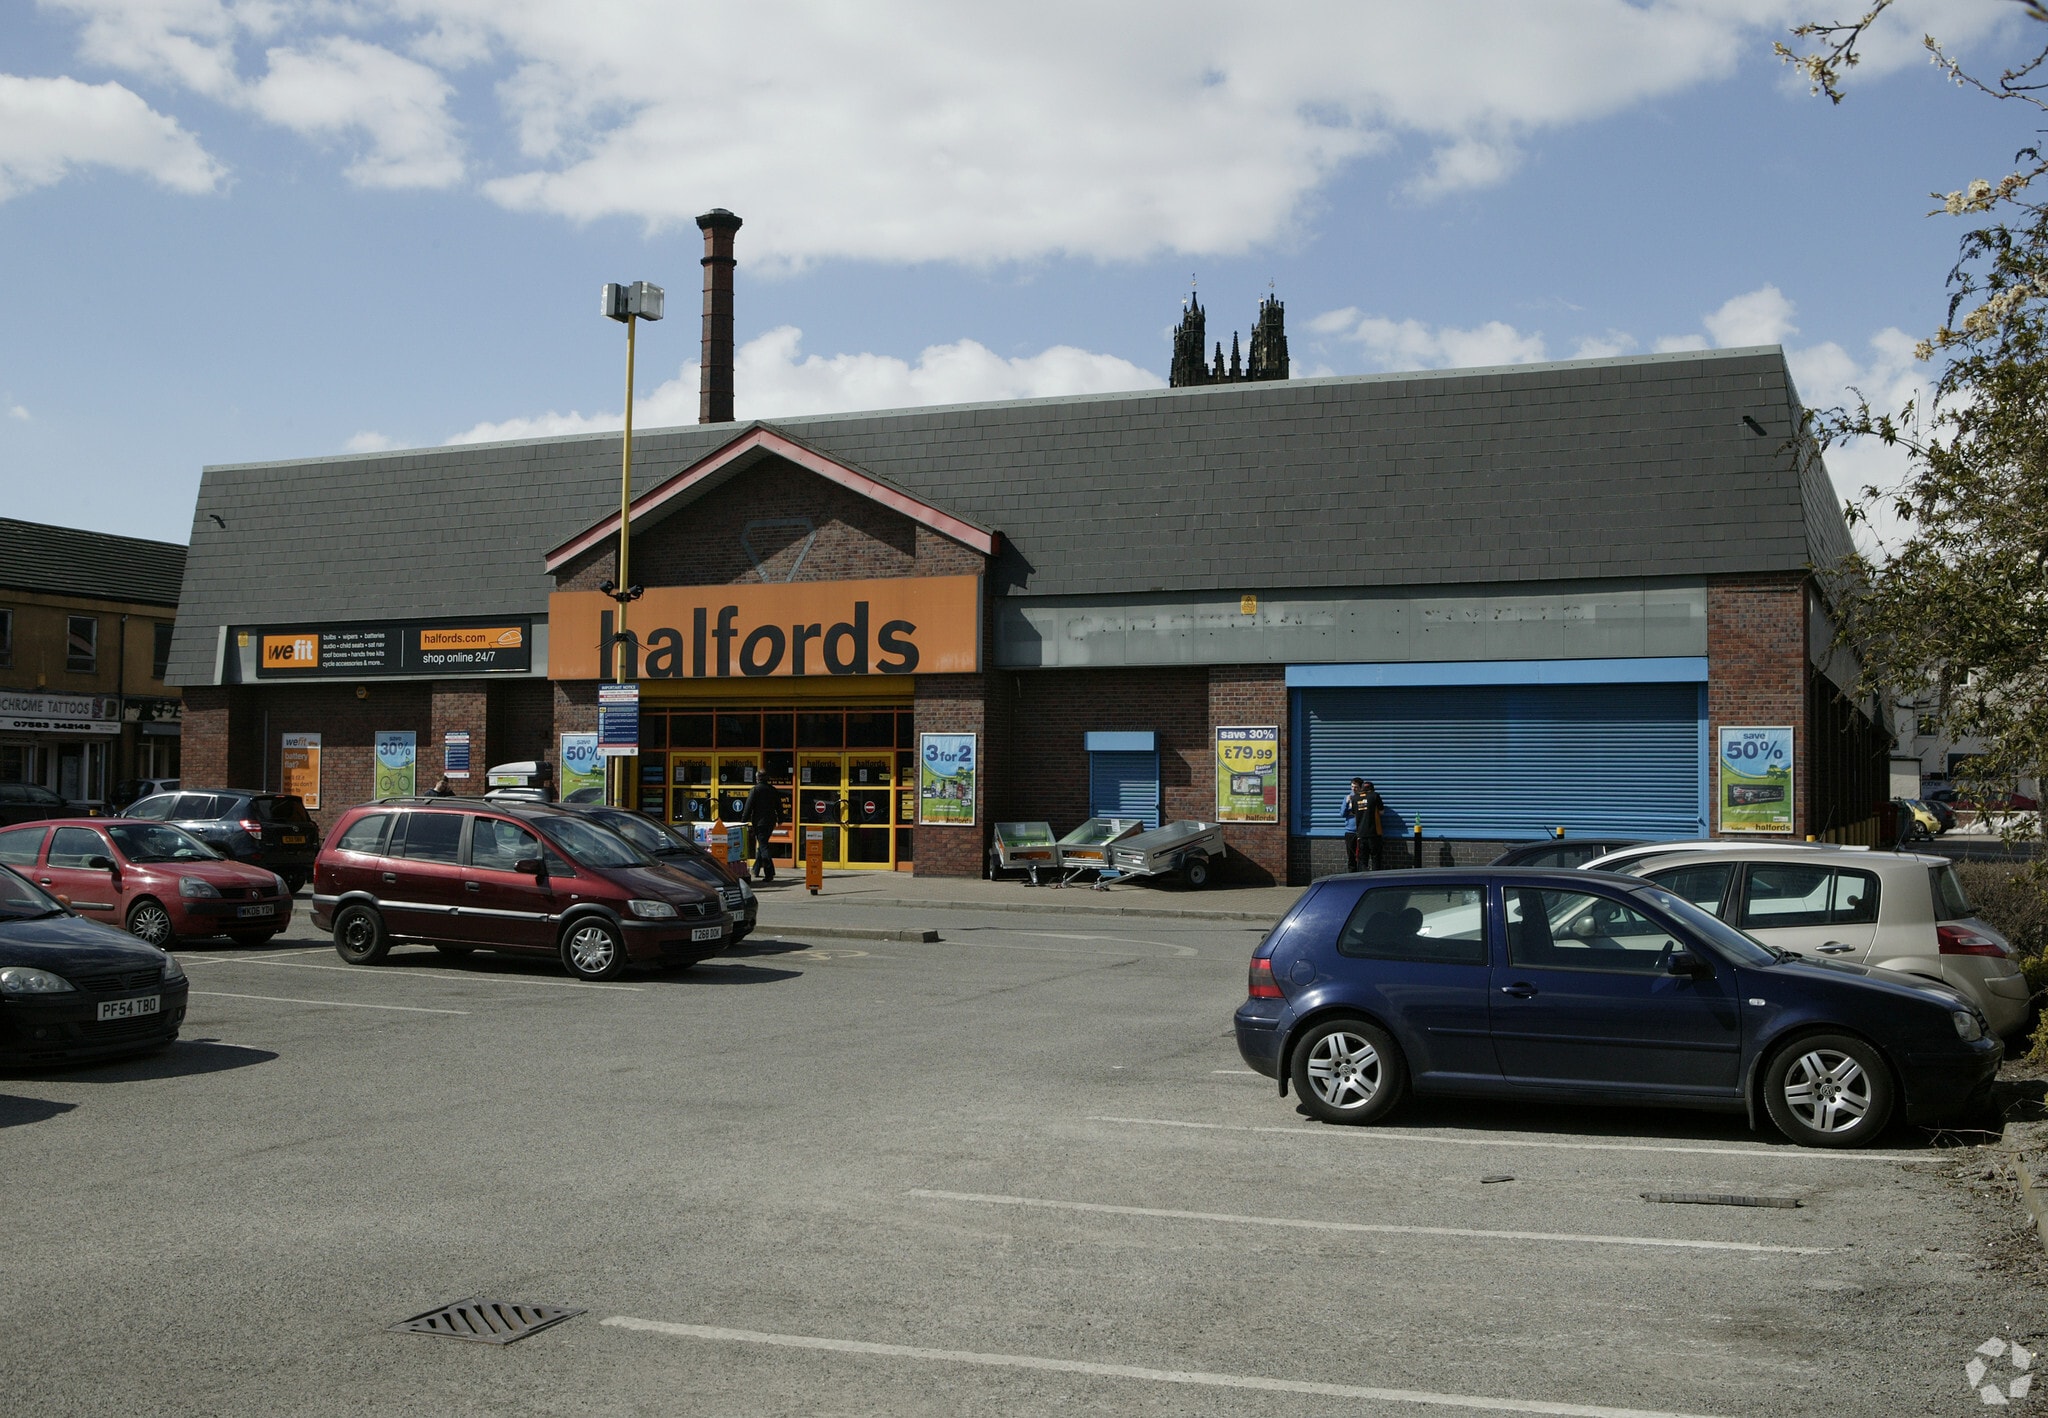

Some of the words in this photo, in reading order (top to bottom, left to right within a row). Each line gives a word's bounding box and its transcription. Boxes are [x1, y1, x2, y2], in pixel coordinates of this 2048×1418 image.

[342, 633, 358, 641] wipers
[424, 633, 486, 643] halfords.com
[600, 601, 920, 678] halfords
[269, 639, 313, 660] wefit
[422, 652, 445, 664] shop
[447, 652, 473, 662] online
[475, 651, 496, 662] 24/7
[0, 698, 43, 712] CHROME
[48, 700, 90, 714] TATTOOS
[1221, 731, 1246, 739] save
[1249, 729, 1274, 739] 30%
[1743, 732, 1766, 740] save
[285, 752, 308, 761] battery
[380, 742, 411, 756] 30%
[566, 745, 602, 761] 50%
[926, 744, 938, 761] 3
[940, 751, 957, 762] for
[958, 745, 972, 762] 2
[1224, 745, 1273, 760] £79.99
[1727, 741, 1783, 760] 50%
[103, 1001, 133, 1018] PF54
[137, 998, 156, 1013] TBO
